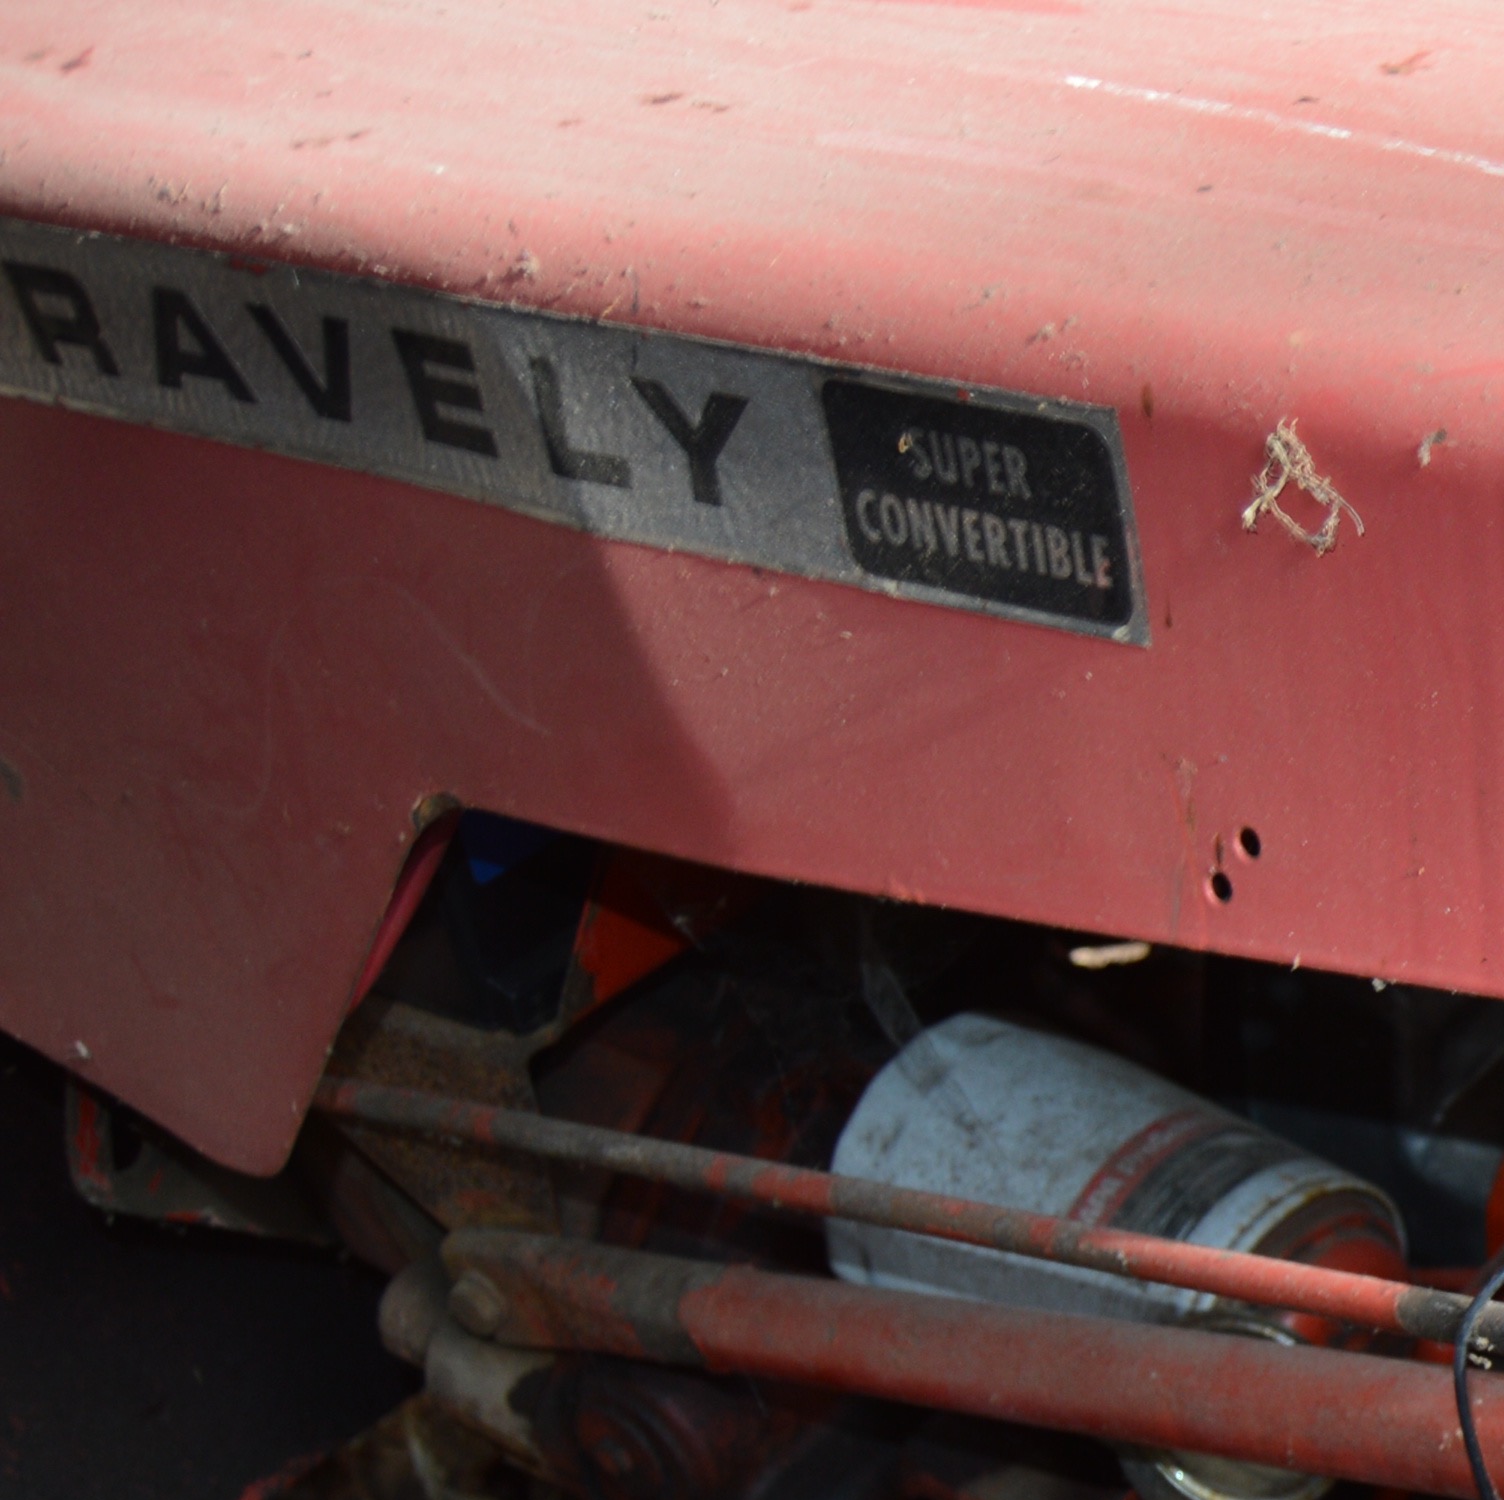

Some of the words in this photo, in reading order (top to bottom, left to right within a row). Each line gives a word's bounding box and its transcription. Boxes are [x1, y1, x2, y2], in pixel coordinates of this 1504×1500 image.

[3, 259, 750, 507] RAVELY
[905, 427, 1031, 499] SUPER
[857, 489, 1112, 587] CONVERTIBLE
